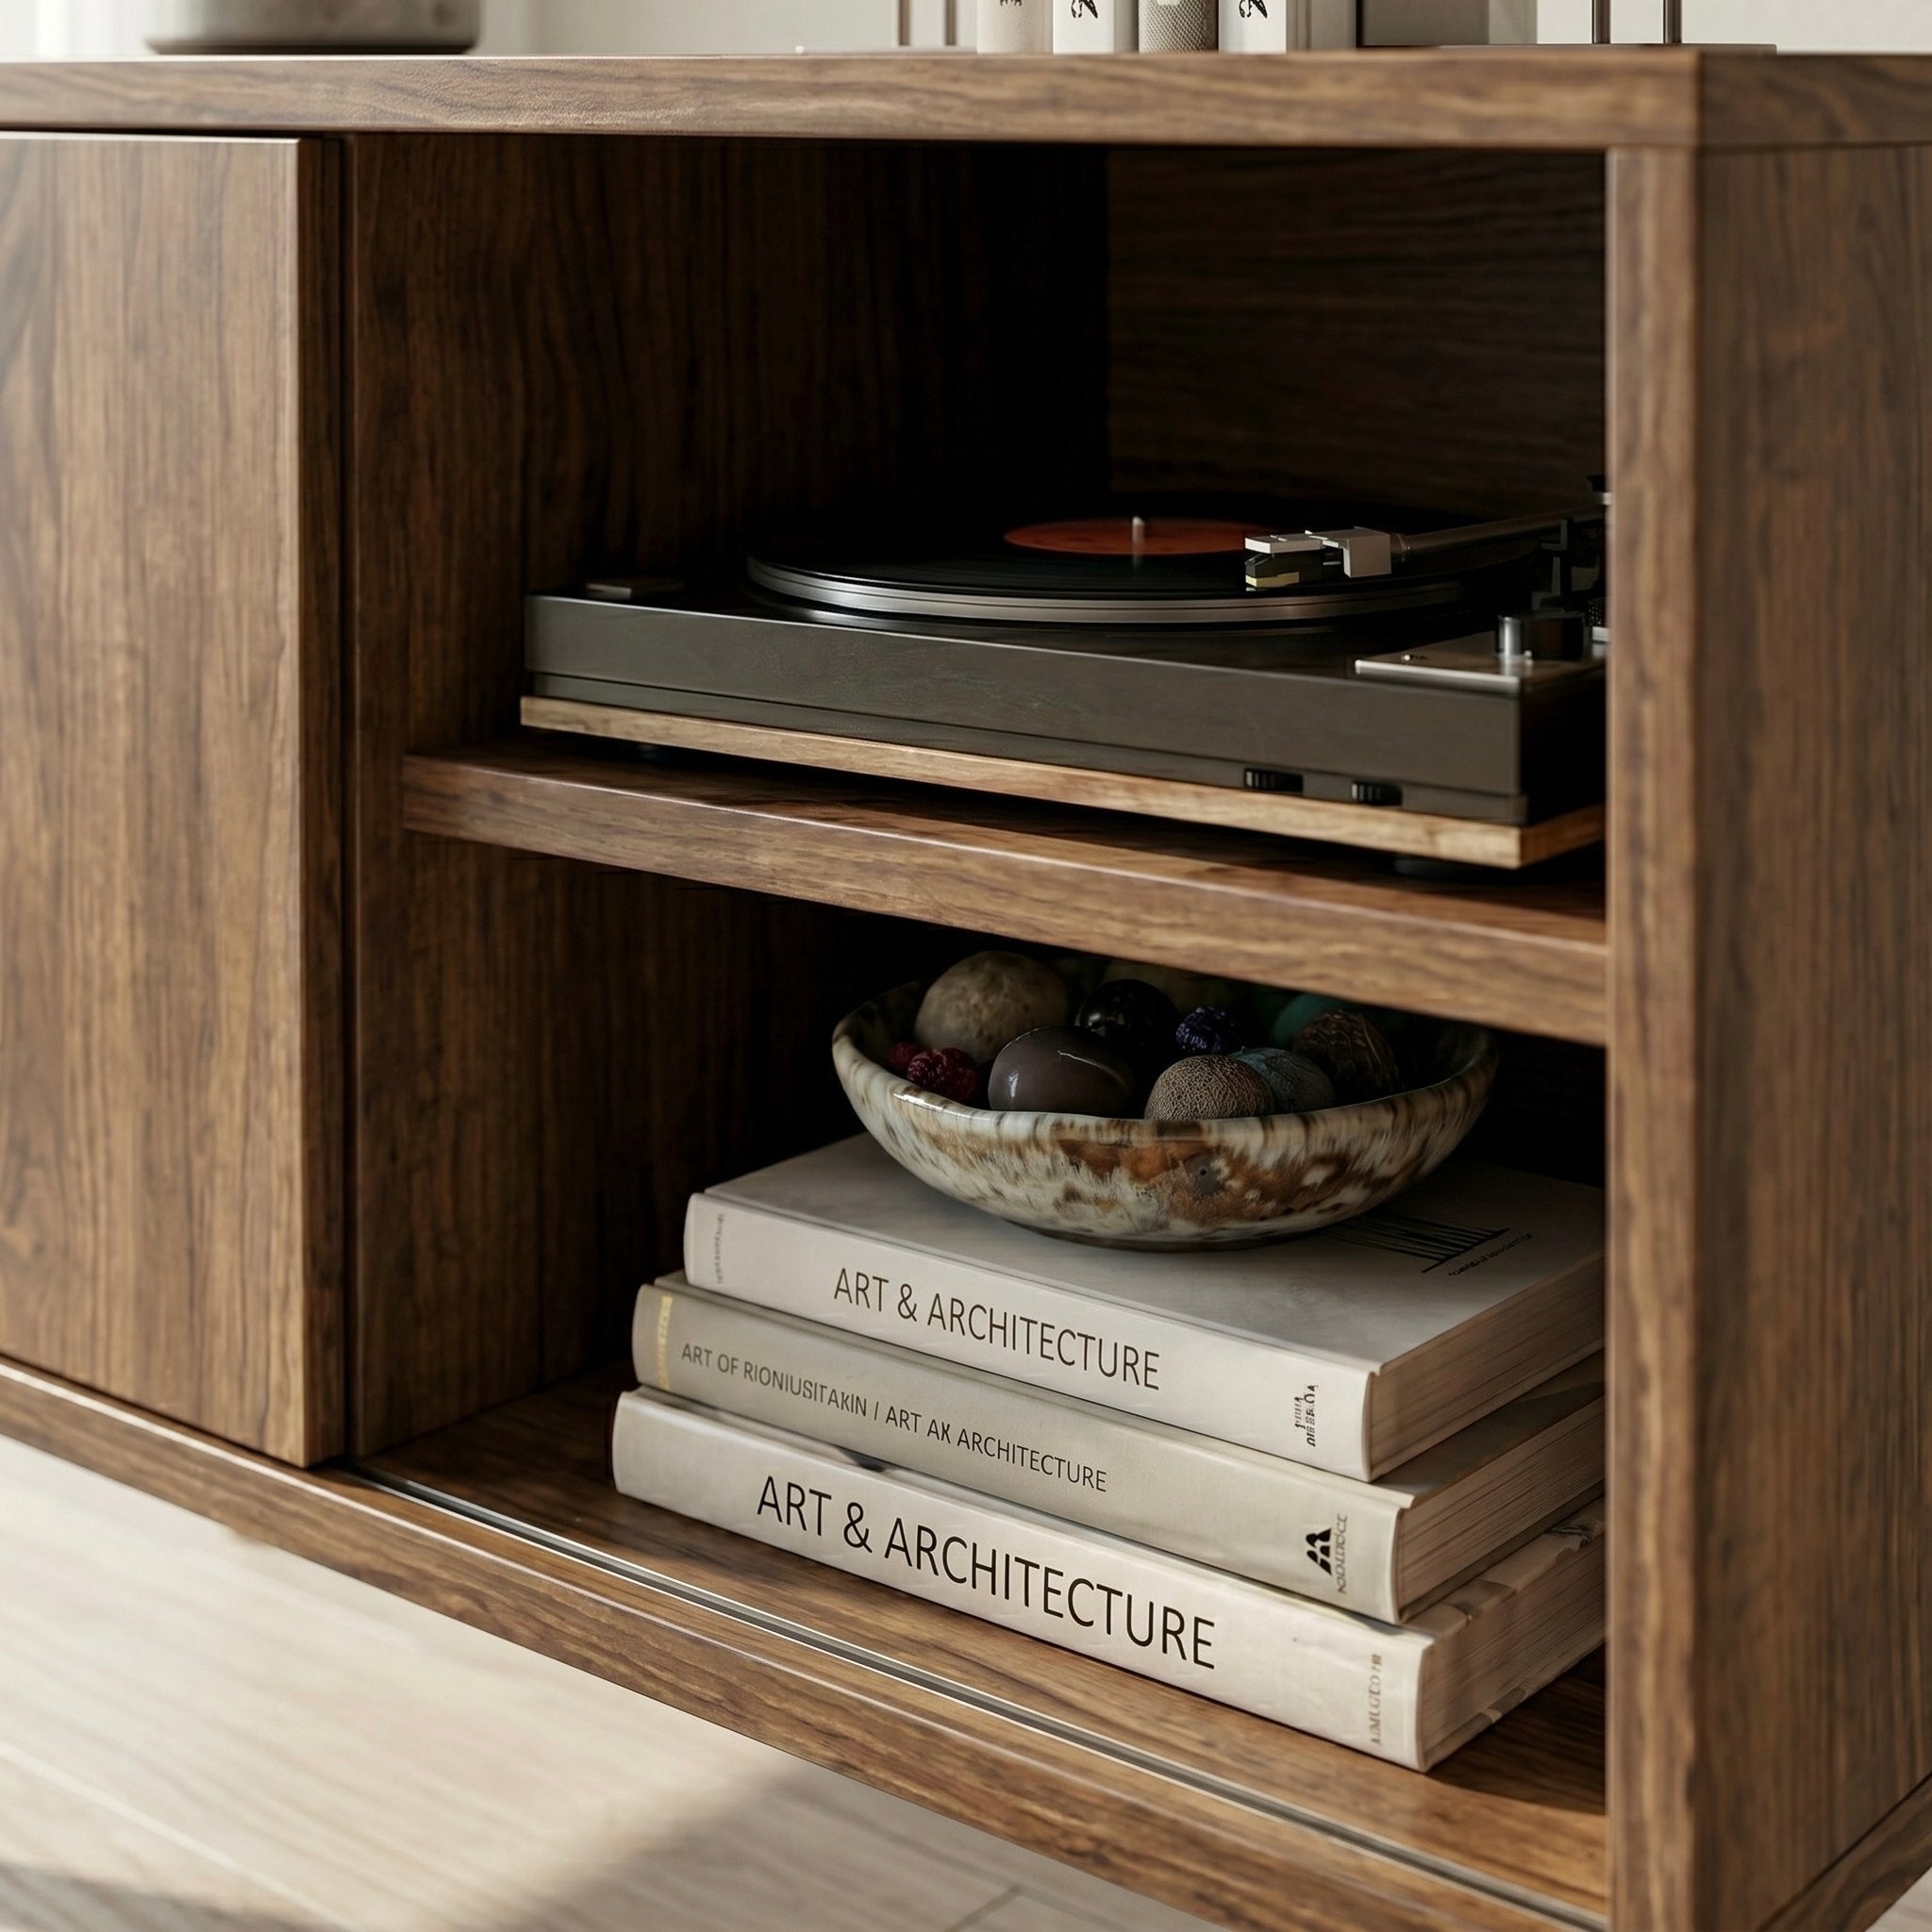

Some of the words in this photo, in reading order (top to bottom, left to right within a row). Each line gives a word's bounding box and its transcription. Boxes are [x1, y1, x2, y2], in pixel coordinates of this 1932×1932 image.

[834, 1268, 889, 1312] ART
[897, 1283, 917, 1322] &
[927, 1293, 1159, 1391] ARCHITECTURE
[681, 1342, 712, 1368] ART
[717, 1354, 739, 1375] OF
[886, 1406, 922, 1433] ART
[957, 1428, 1107, 1492] ARCHITECTURE
[757, 1475, 832, 1537] ART
[843, 1502, 873, 1554] &
[884, 1517, 1215, 1670] ARCHITECTURE
